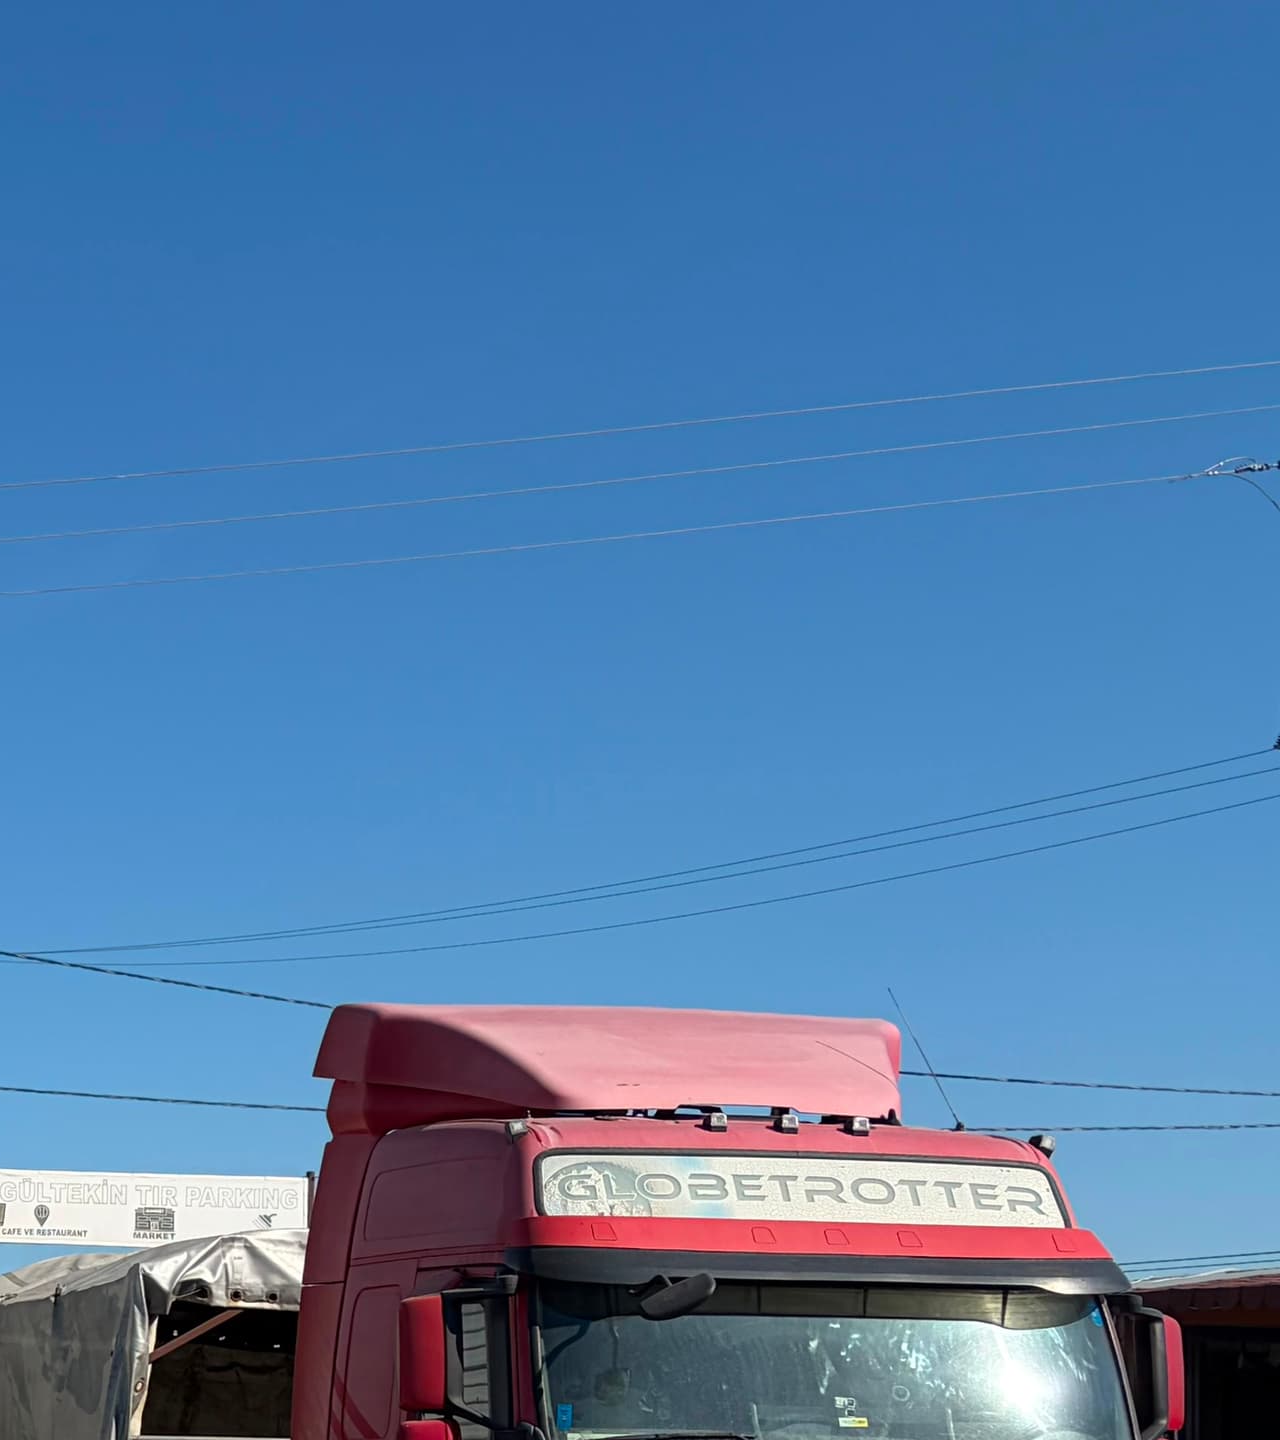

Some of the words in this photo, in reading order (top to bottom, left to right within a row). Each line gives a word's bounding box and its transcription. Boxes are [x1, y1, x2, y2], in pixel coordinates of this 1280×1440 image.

[0, 1178, 128, 1205] GÜLTEKİN
[135, 1185, 178, 1207] TIR
[185, 1186, 298, 1209] PARKING
[558, 1173, 1048, 1216] GLOBETROTTER
[2, 1228, 21, 1236] CAFE
[37, 1229, 88, 1238] RESTAURANT
[133, 1232, 176, 1240] MARKET
